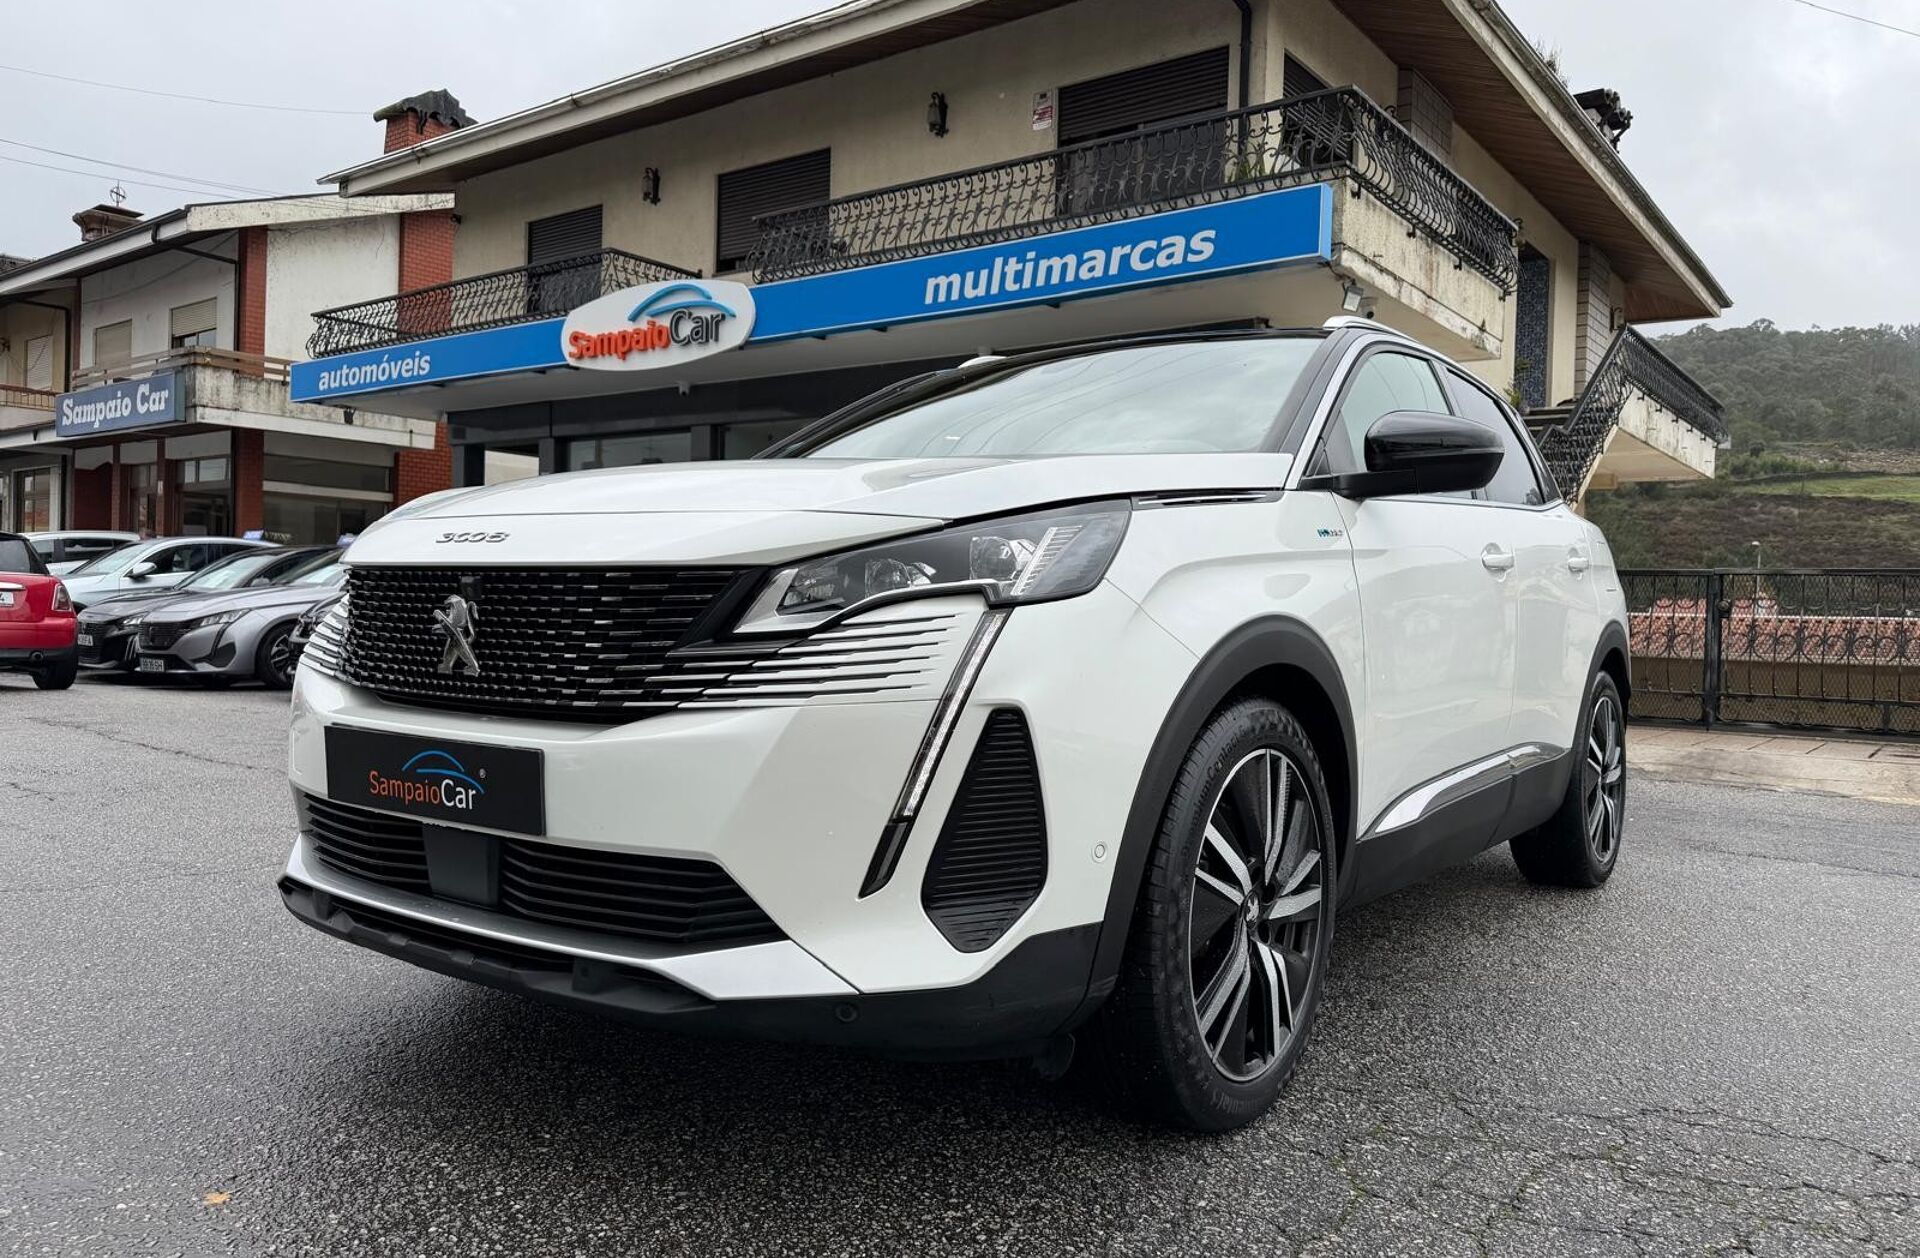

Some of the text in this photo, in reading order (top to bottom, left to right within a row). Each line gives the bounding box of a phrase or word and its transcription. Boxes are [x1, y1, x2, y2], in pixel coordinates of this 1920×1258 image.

[924, 229, 1217, 305] multimarcas
[318, 350, 431, 391] automóveis
[62, 383, 169, 428] Sampaio Car
[368, 770, 477, 810] SampaioCar
